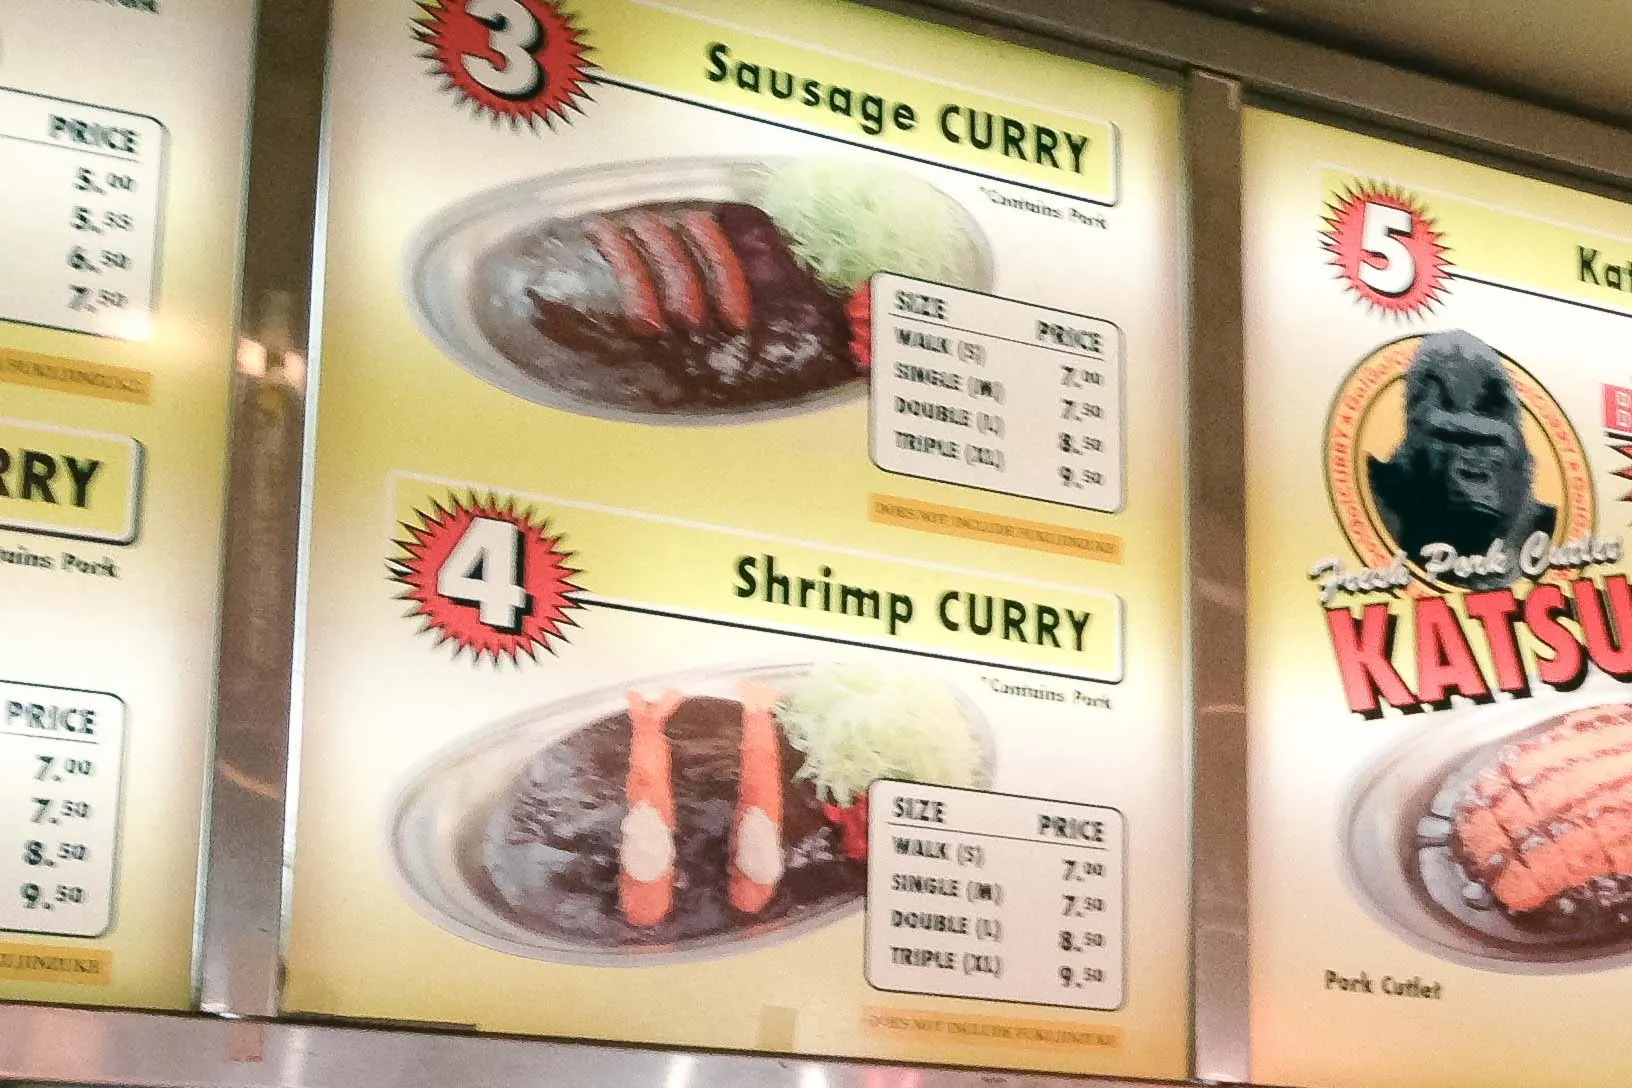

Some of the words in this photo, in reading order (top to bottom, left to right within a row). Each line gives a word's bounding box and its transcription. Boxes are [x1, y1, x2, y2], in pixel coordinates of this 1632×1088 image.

[461, 0, 546, 101] 3
[705, 42, 916, 136] Sausage
[939, 103, 1090, 175] CURRY
[49, 114, 139, 153] PRICE
[1358, 202, 1417, 297] 5
[894, 290, 947, 319] SIZE
[1035, 320, 1104, 353] PRICE
[893, 361, 964, 392] SINGLE
[893, 395, 972, 428] DOUBLE
[893, 431, 960, 459] TRIPLE
[60, 551, 119, 579] Pork
[437, 516, 533, 635] 4
[733, 554, 914, 635] Shrimp
[938, 590, 1092, 652] CURRY
[5, 700, 97, 735] PRICE
[34, 754, 93, 782] 7.00
[31, 796, 90, 825] 7.50
[893, 796, 947, 823] SIZE
[1038, 813, 1105, 843] PRICE
[23, 840, 88, 868] 8.50
[892, 836, 950, 861] WALK
[20, 882, 86, 911] 9.50
[891, 873, 960, 898] SINGLE
[891, 909, 968, 936] DOUBLE
[890, 945, 956, 970] TRIPLE
[1325, 969, 1372, 994] Pork
